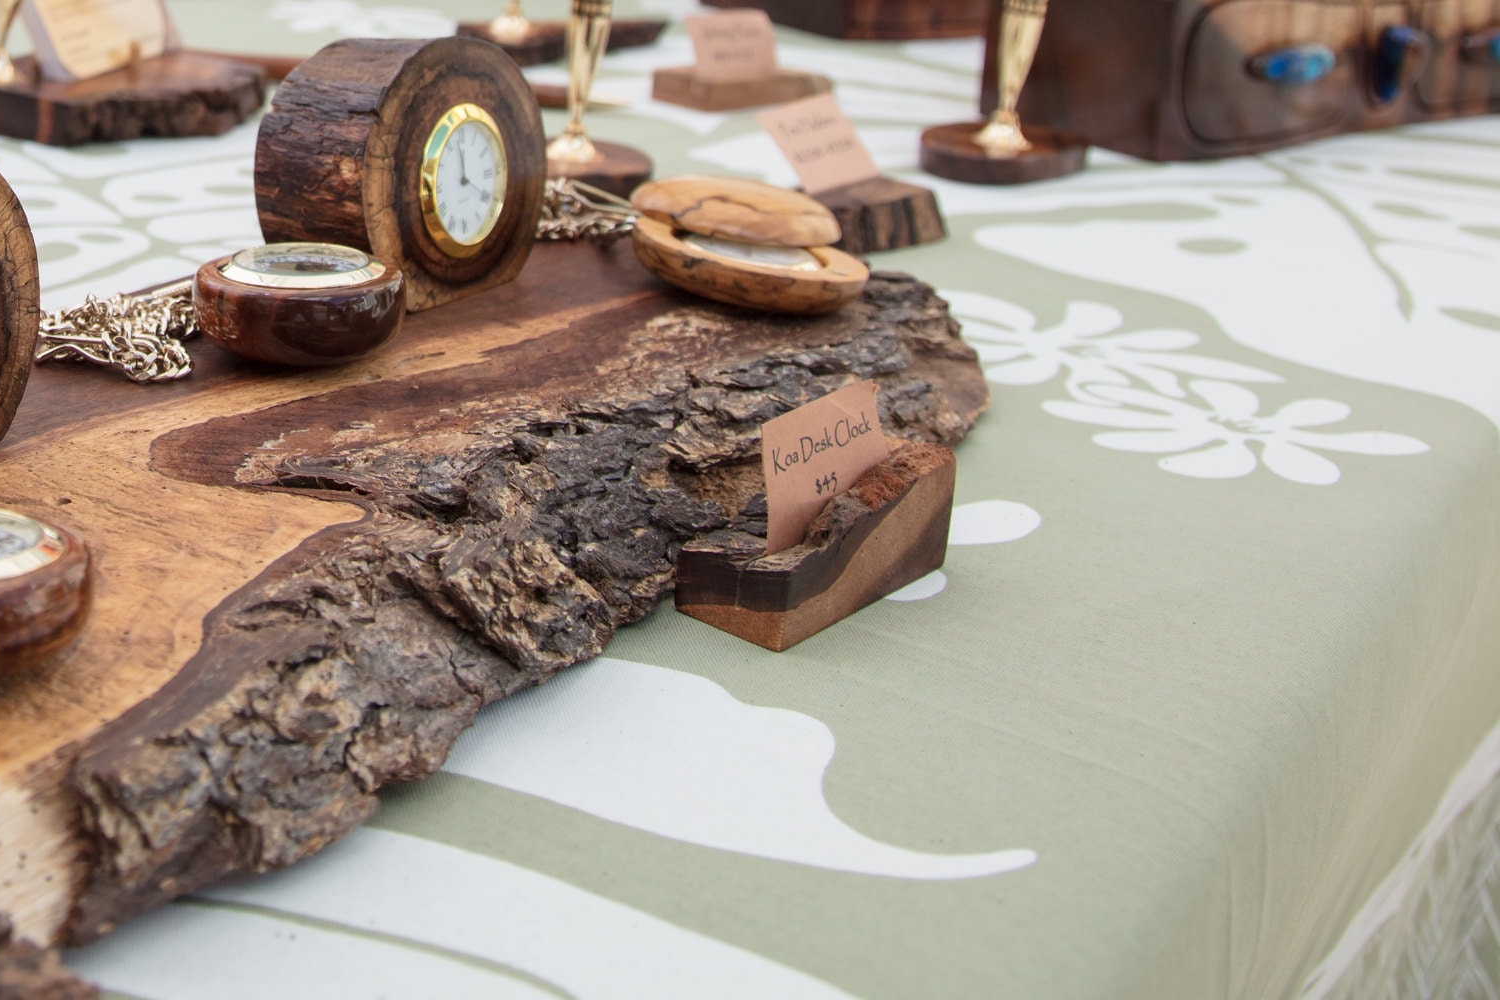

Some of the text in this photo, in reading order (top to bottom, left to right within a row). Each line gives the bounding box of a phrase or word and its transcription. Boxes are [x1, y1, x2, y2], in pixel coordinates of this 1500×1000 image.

[772, 411, 873, 476] Koa Desk Clock
[815, 471, 838, 496] $45
